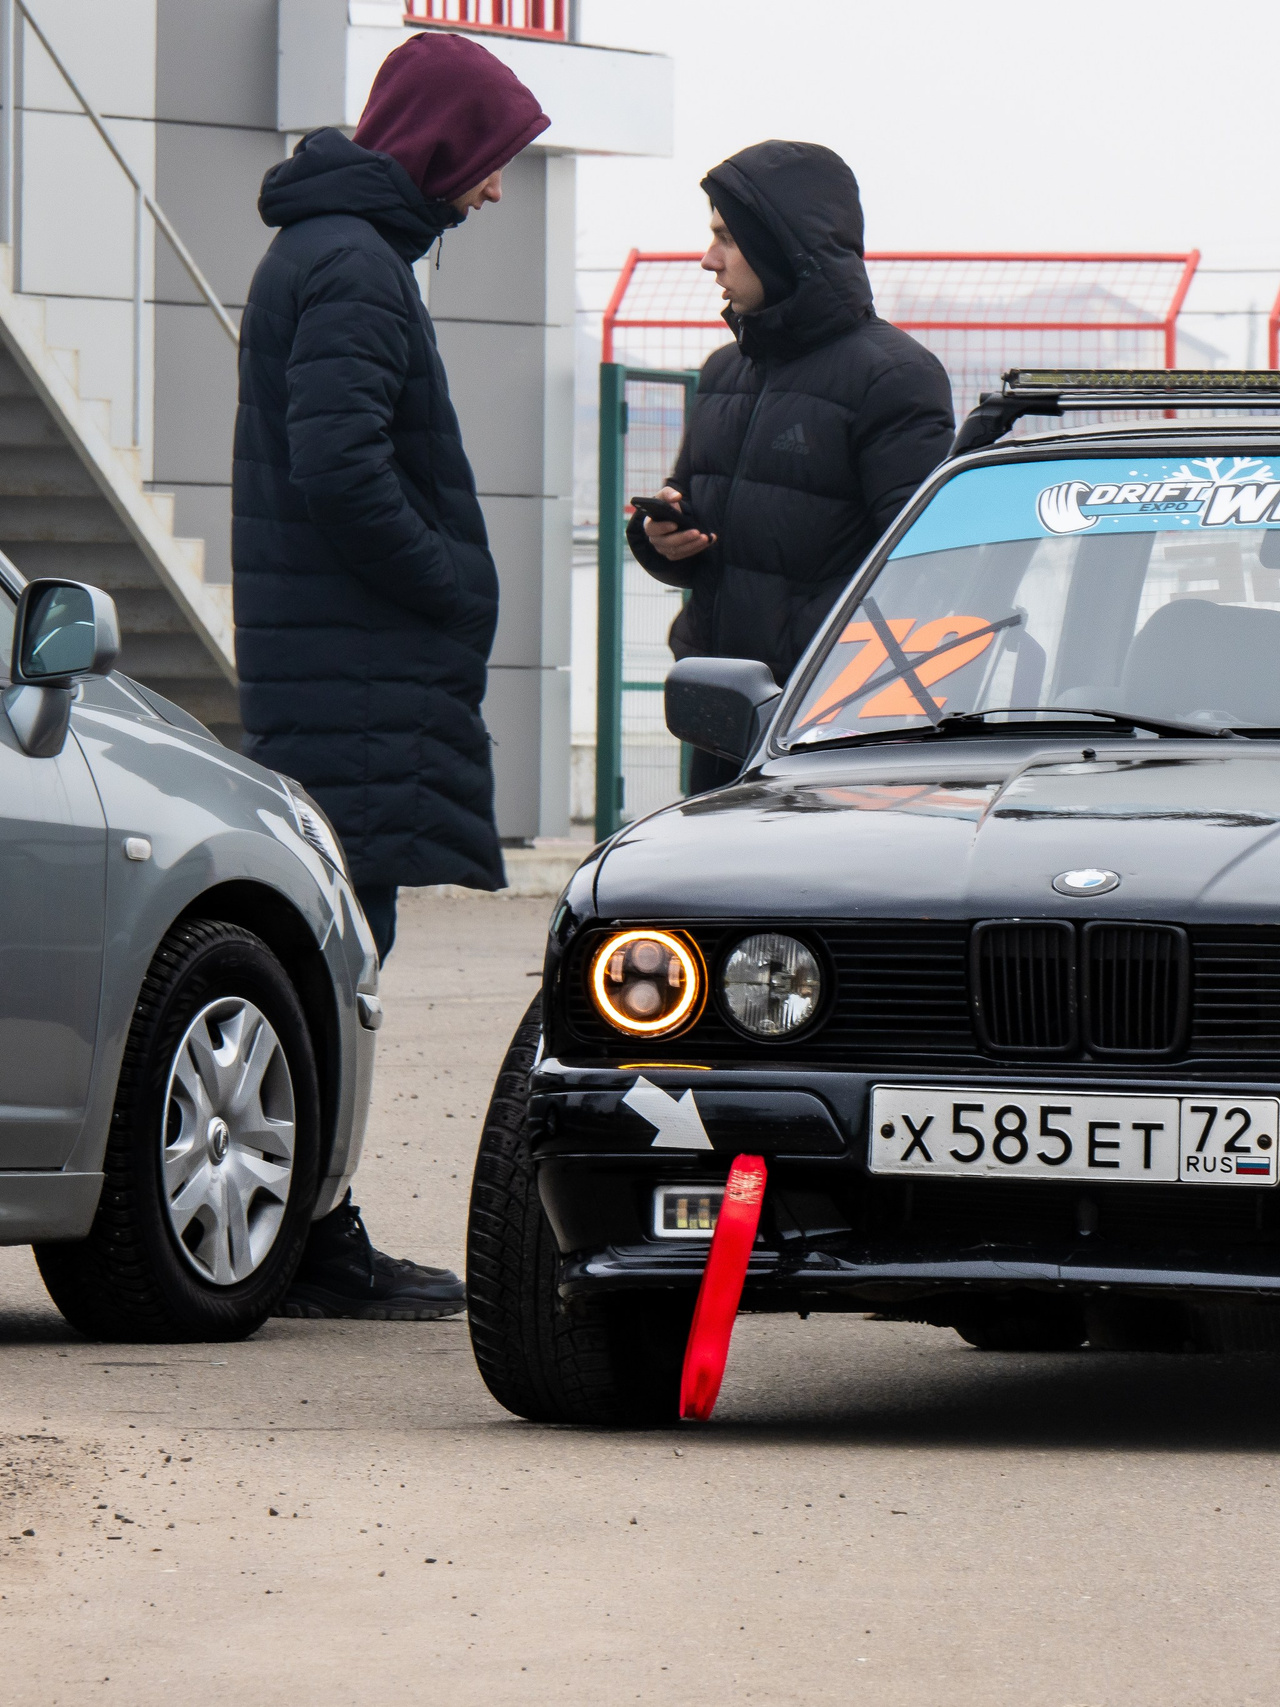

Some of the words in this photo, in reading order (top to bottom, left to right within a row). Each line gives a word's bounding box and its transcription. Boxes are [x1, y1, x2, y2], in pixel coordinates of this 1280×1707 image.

[1085, 481, 1213, 505] DRIFT
[1139, 501, 1189, 513] EXPO
[1190, 1105, 1252, 1153] 72
[1186, 1155, 1233, 1173] RUS
